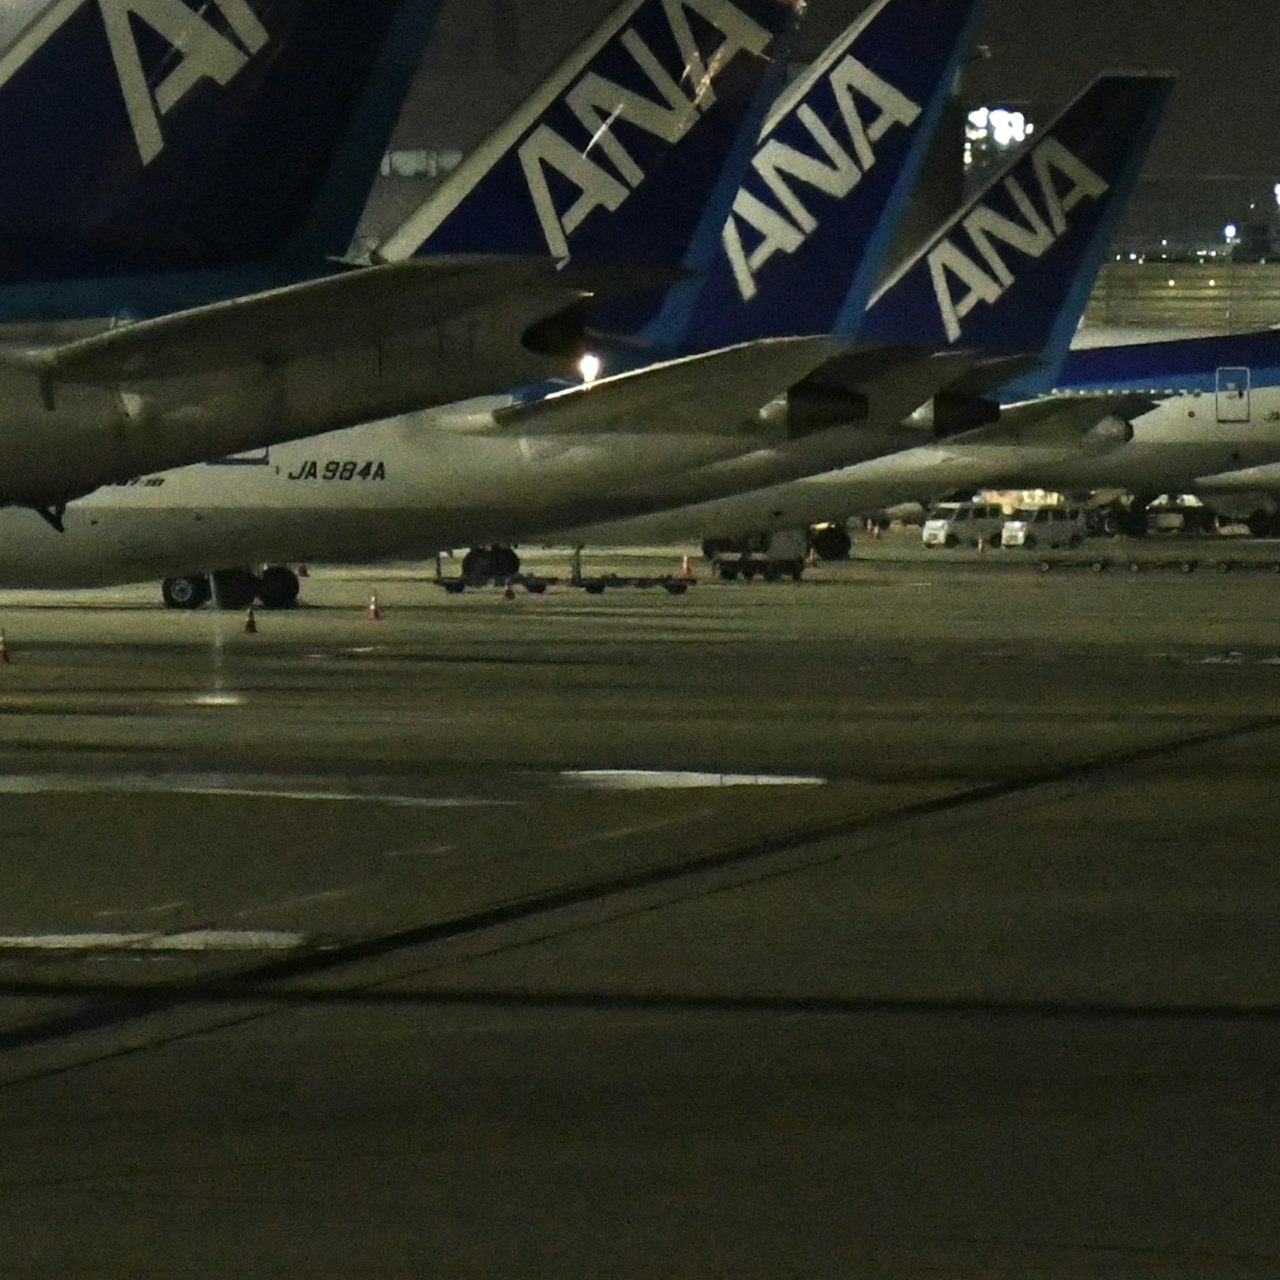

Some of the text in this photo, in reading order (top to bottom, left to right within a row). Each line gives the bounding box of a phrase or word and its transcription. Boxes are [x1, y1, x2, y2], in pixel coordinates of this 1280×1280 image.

[722, 54, 923, 303] ANA
[927, 135, 1110, 344] ANA
[288, 461, 385, 480] JA984A
